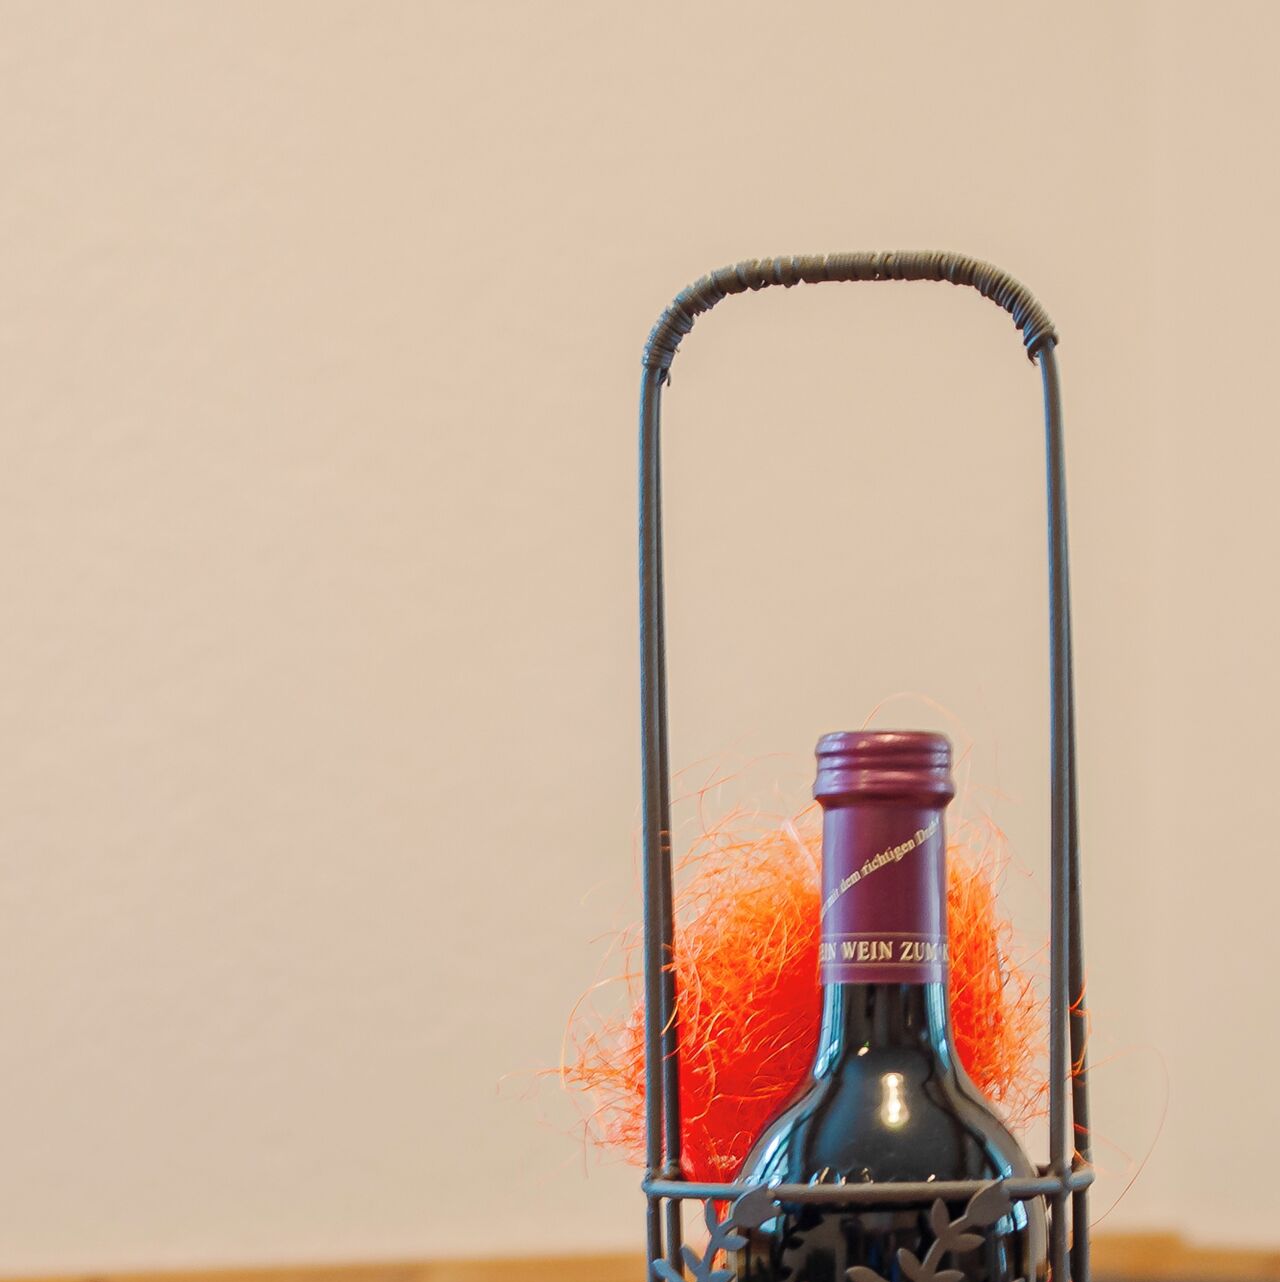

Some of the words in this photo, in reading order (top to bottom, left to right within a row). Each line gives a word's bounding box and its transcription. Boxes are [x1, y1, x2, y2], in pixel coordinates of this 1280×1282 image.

[860, 839, 916, 877] richtigen
[842, 941, 893, 961] WEIN
[900, 941, 938, 961] ZUM
